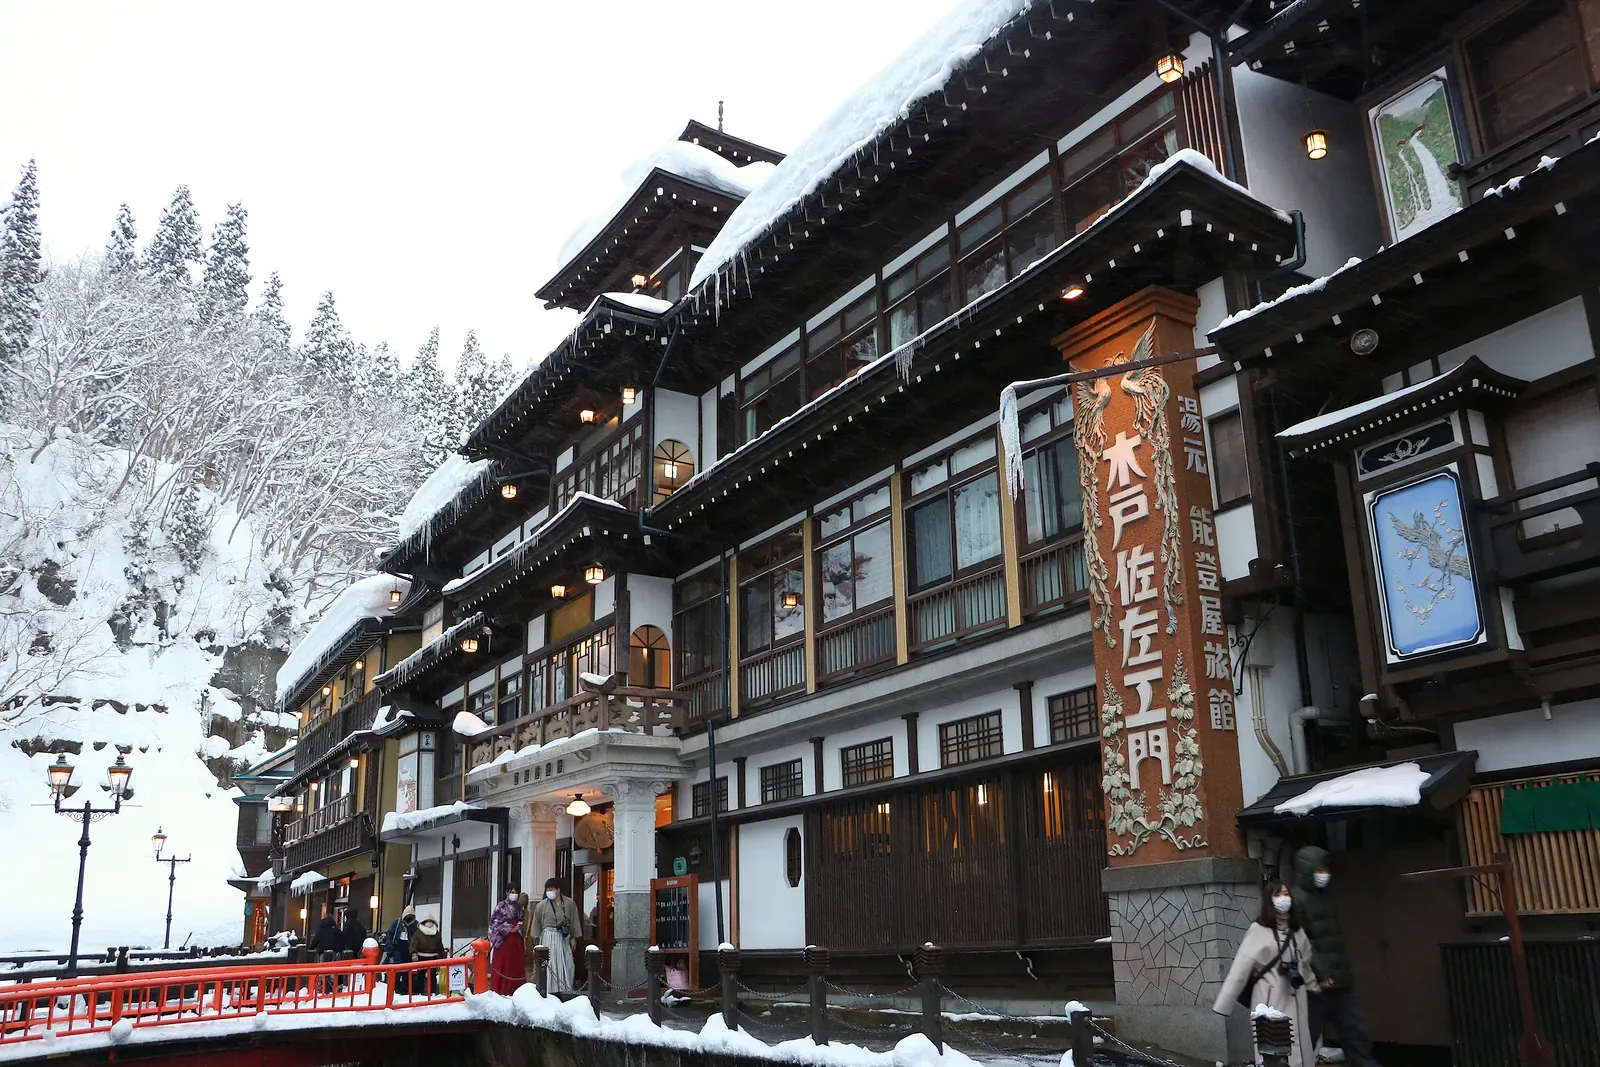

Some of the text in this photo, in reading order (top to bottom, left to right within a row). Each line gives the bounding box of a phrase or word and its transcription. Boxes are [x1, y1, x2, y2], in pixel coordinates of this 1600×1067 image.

[1178, 396, 1235, 730] 湯元 能登屋旅館
